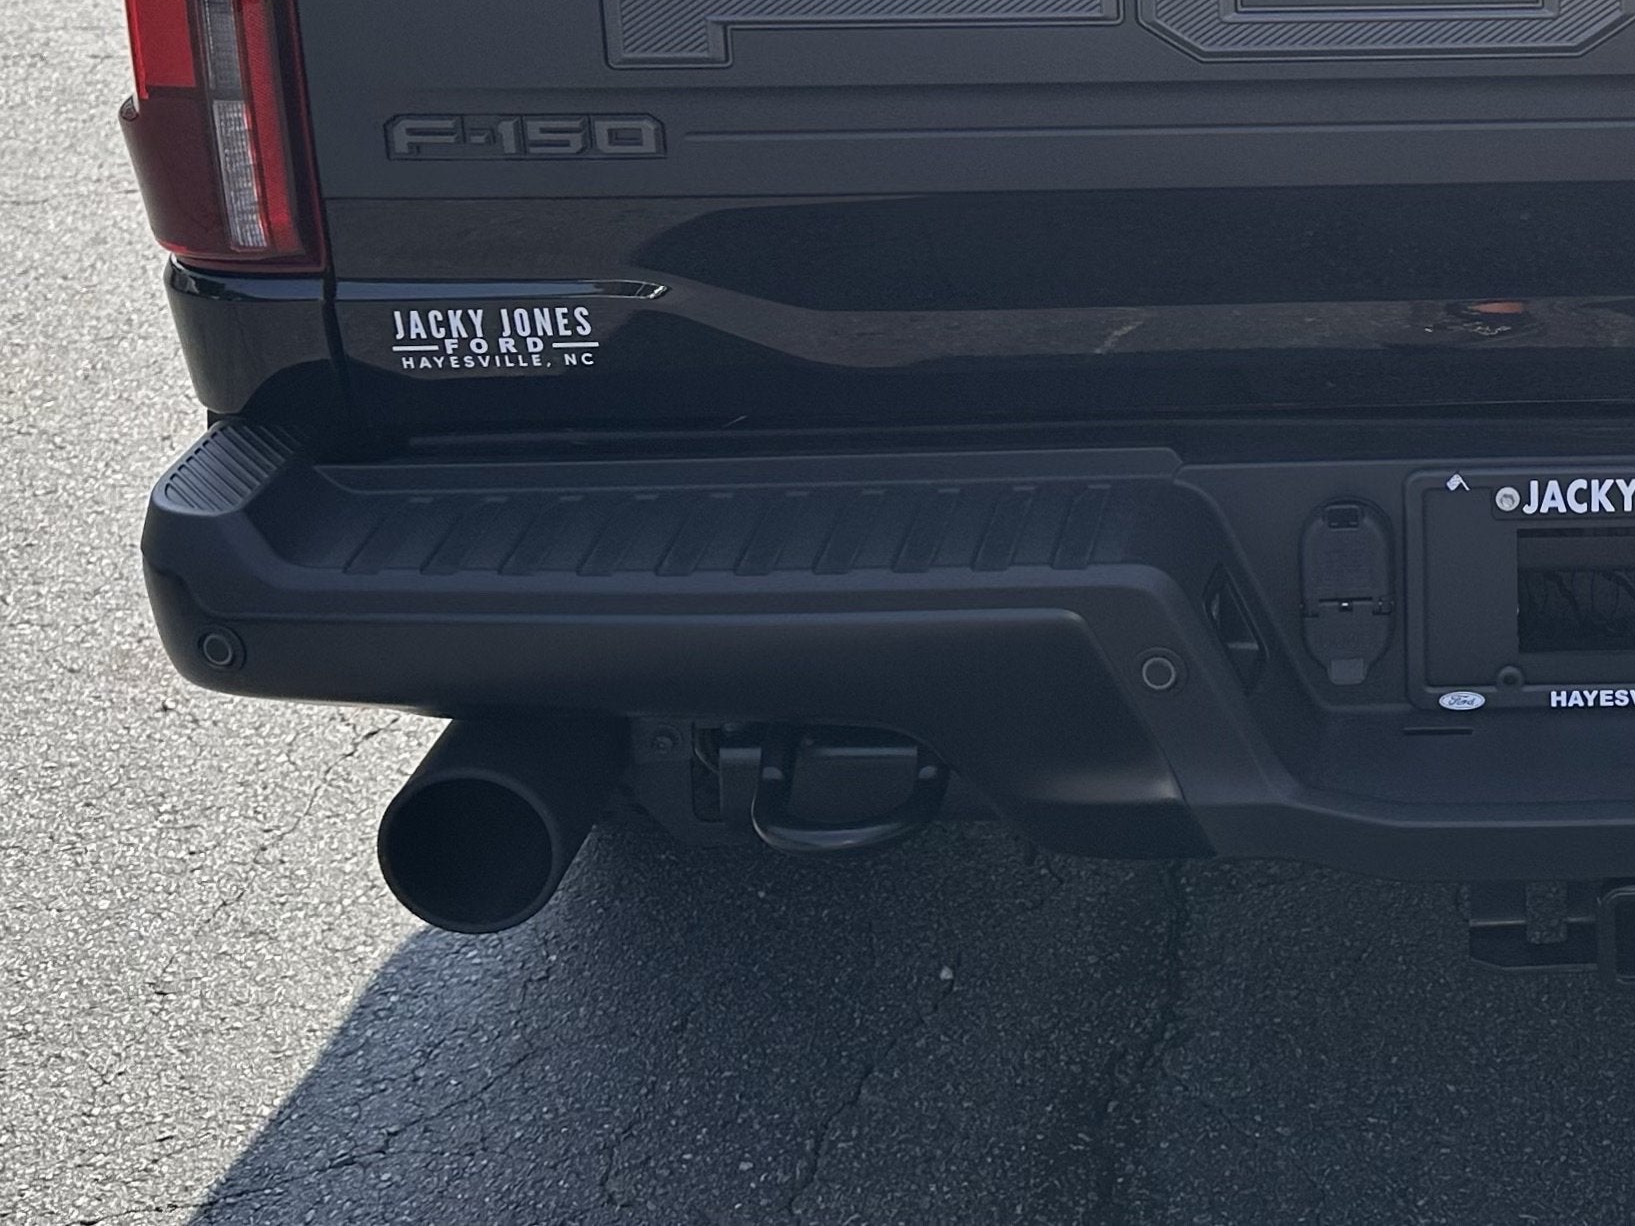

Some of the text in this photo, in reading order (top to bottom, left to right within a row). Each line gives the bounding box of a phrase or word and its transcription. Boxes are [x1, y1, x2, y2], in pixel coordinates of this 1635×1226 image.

[385, 113, 666, 161] F-150
[393, 306, 592, 340] JACKY JONES
[444, 337, 545, 355] FORD
[401, 352, 595, 370] HAYESVILLE, NC
